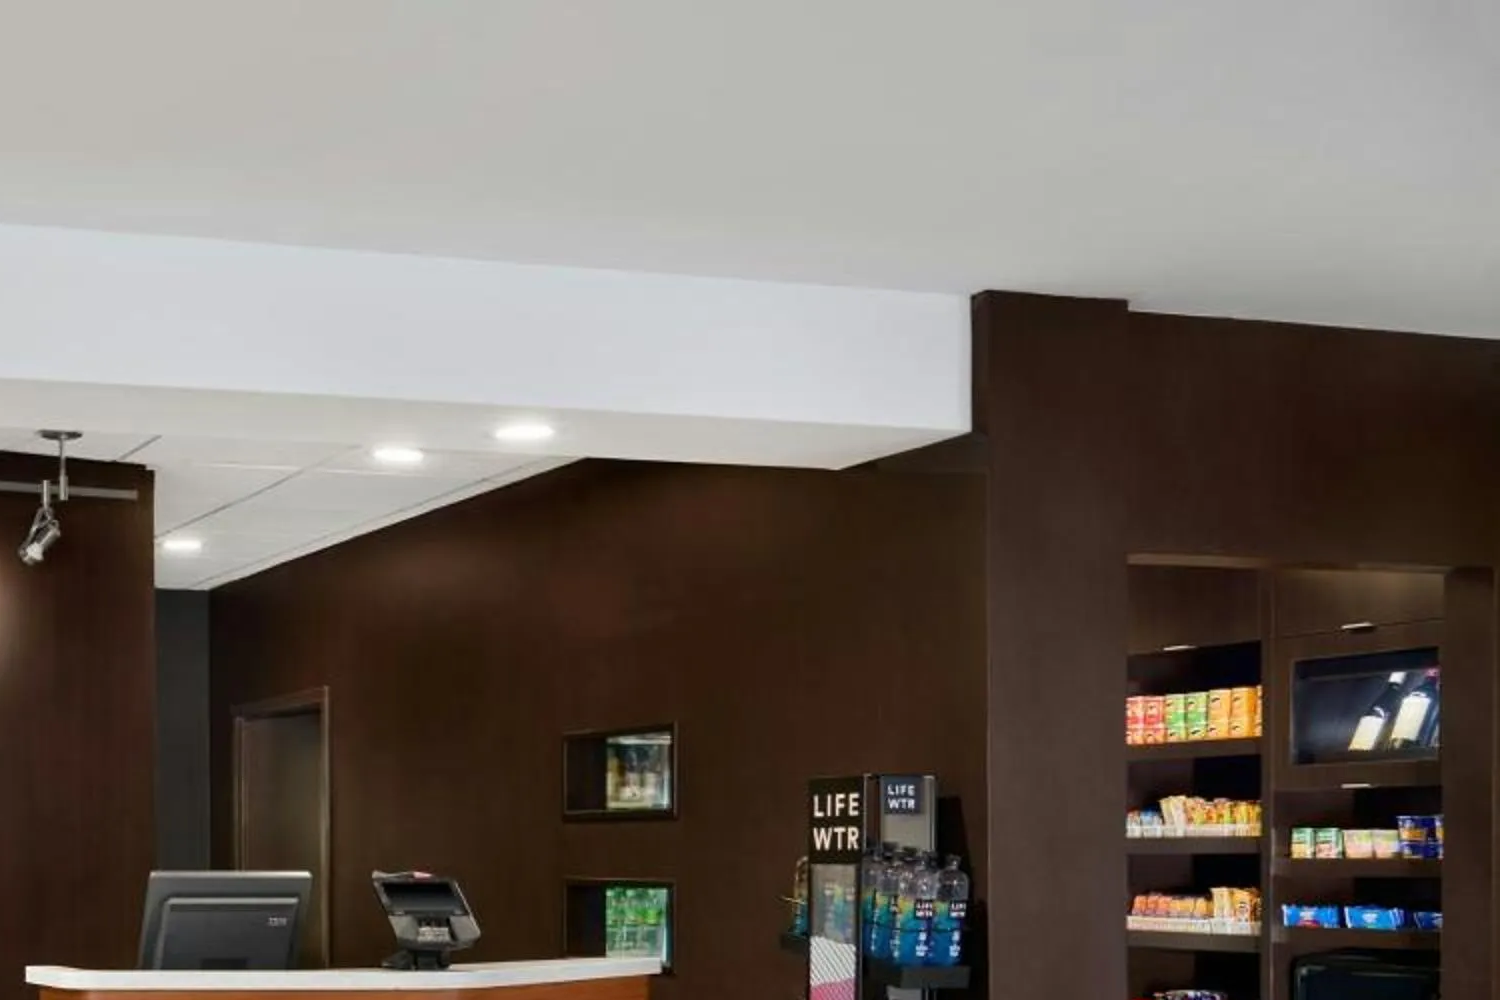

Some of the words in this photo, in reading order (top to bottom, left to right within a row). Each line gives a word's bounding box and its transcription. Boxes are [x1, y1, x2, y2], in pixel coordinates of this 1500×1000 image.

[886, 784, 916, 797] LIFE
[813, 793, 860, 817] LIFE
[887, 798, 916, 810] WTR
[813, 826, 860, 851] WTR
